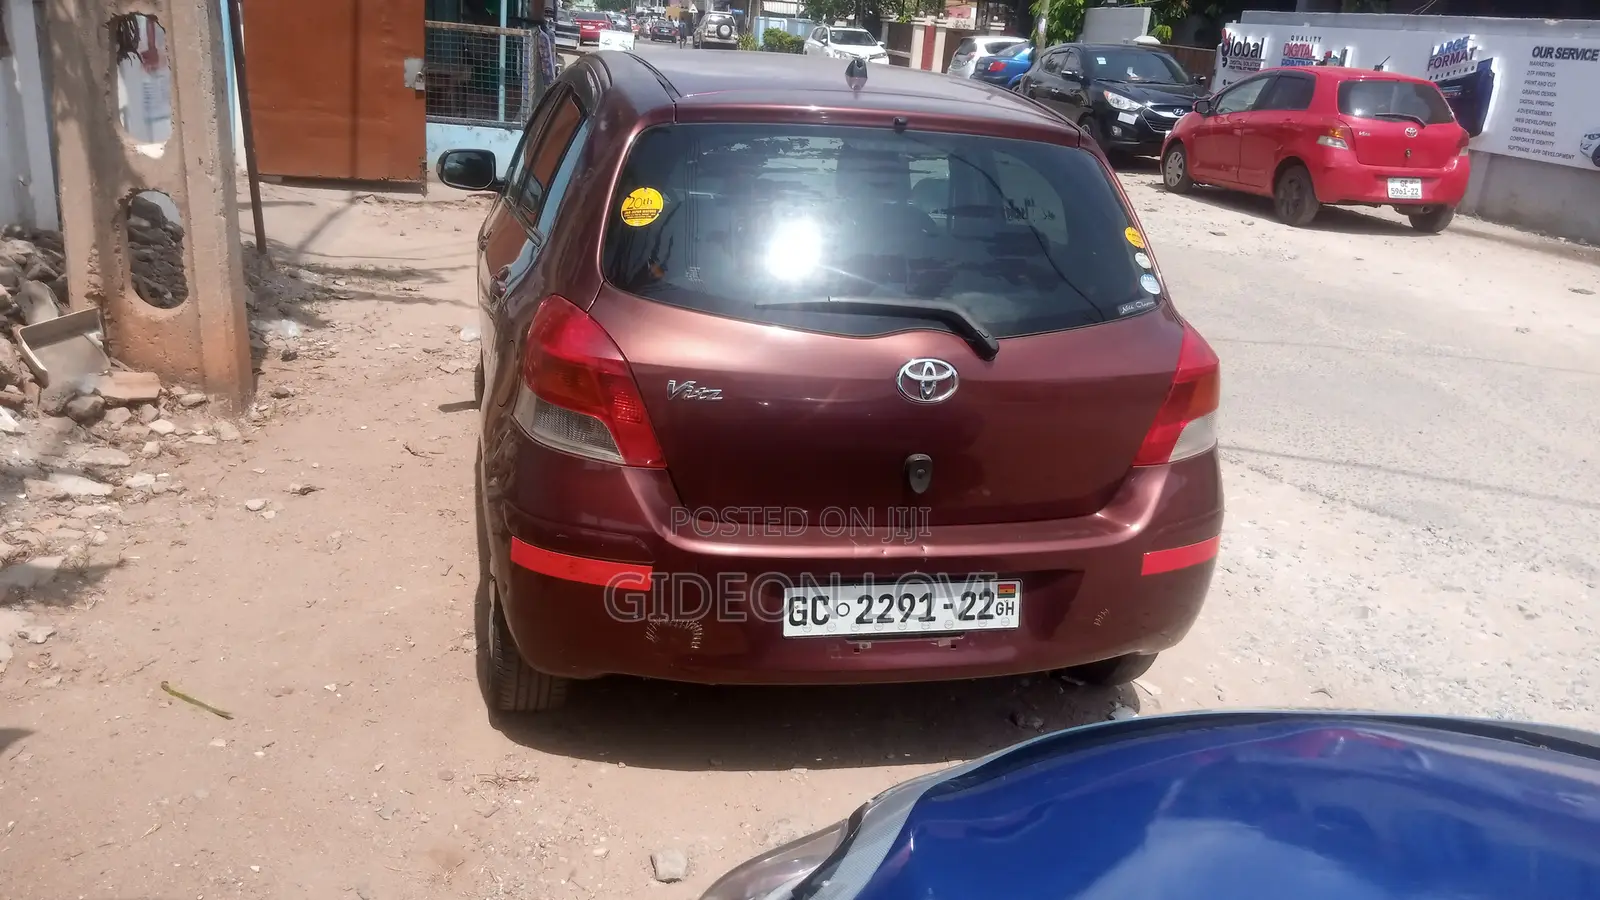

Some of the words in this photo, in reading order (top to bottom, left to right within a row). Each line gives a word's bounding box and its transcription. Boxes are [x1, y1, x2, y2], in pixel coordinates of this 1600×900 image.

[1291, 35, 1322, 43] QUALITY
[1283, 43, 1315, 58] DIGITAL
[1430, 36, 1470, 58] LARGE
[1532, 46, 1554, 59] OUR
[1555, 47, 1600, 61] SERVICE
[1427, 46, 1477, 71] FORMAT
[1429, 66, 1475, 80] PRINTING
[1517, 108, 1553, 117] ADVERTISEMENT
[1525, 118, 1557, 127] DEVELOPMENT
[1532, 129, 1555, 137] BRANDING
[1510, 136, 1535, 144] CORPORATE
[1536, 139, 1555, 147] IDENTITY
[1542, 150, 1575, 159] DEVELOPMENT
[626, 196, 653, 209] 20th
[667, 380, 723, 400] Vitz
[788, 595, 831, 627] GC
[996, 601, 1015, 616] GH
